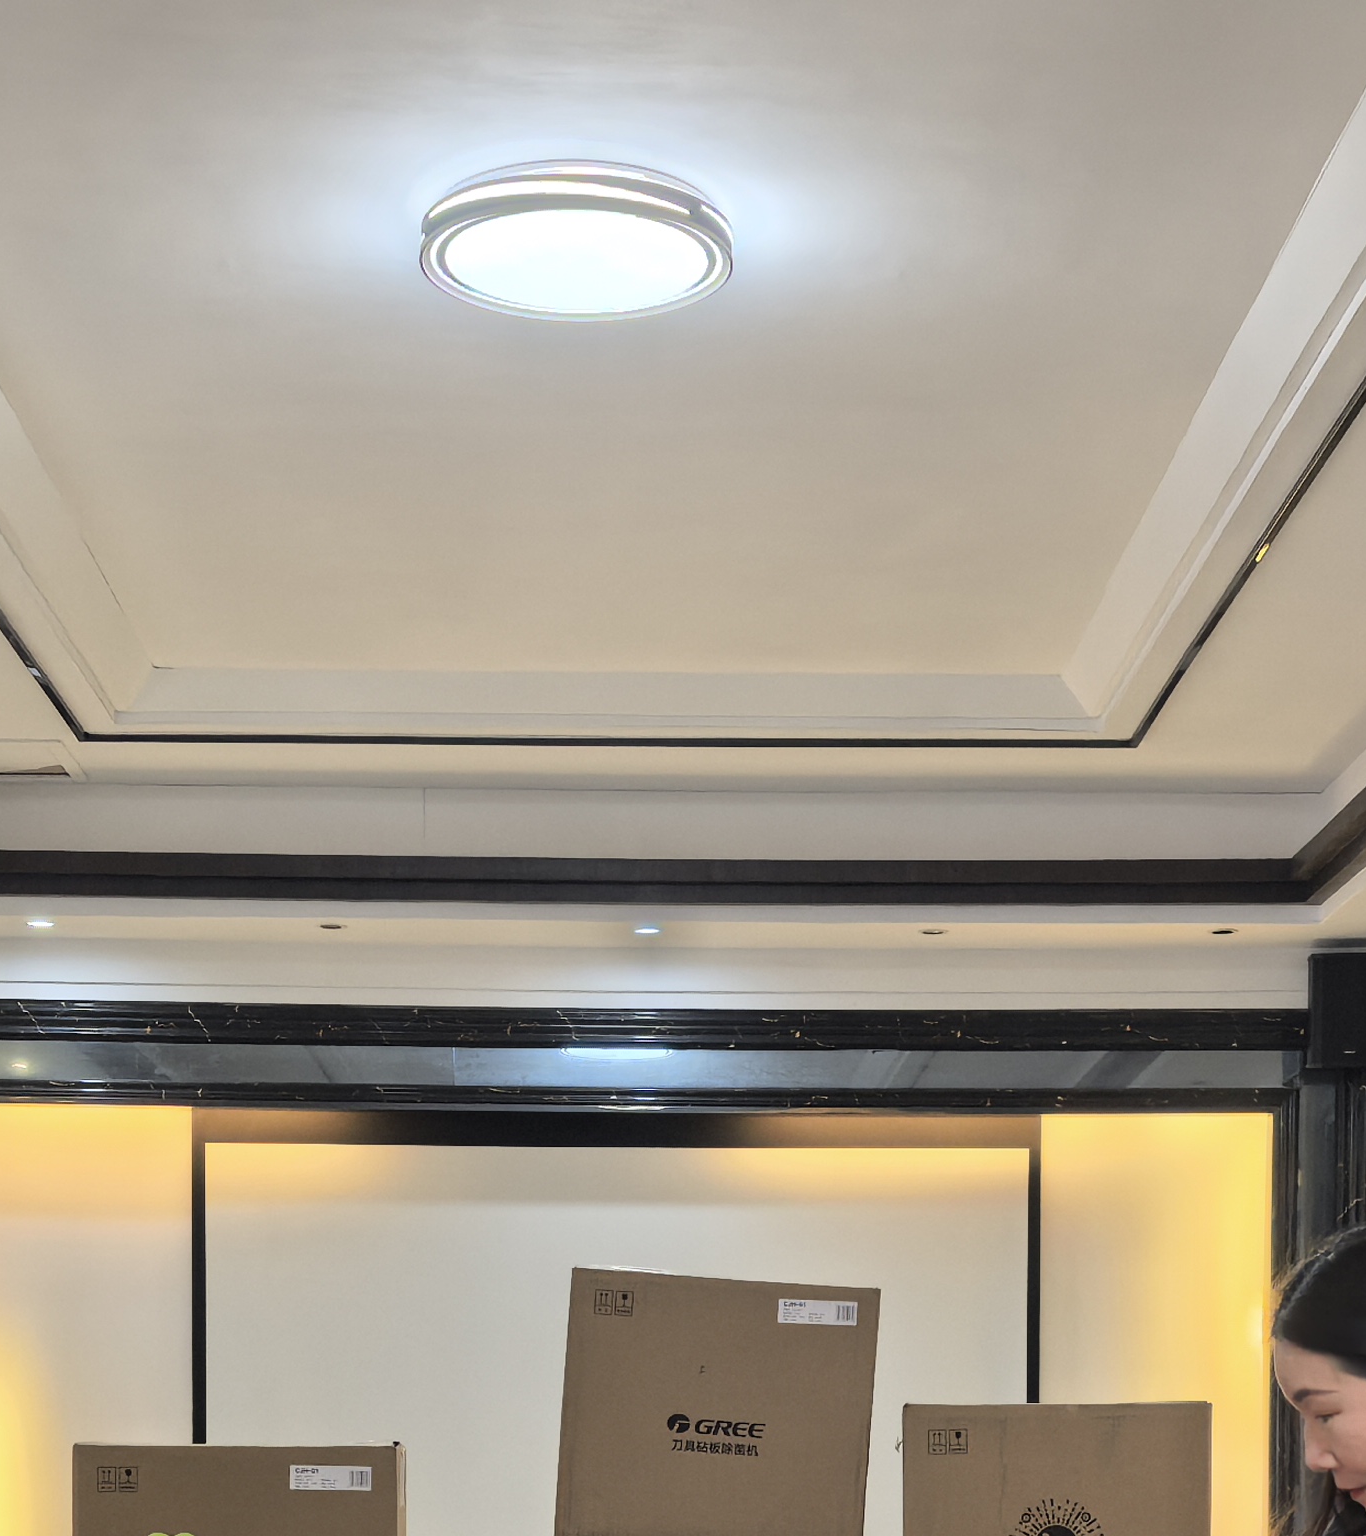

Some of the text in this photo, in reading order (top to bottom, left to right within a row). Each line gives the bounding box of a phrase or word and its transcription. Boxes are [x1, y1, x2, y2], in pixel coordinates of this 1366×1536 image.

[694, 1418, 766, 1440] GREE
[671, 1439, 759, 1458] 刀具砧板除菌机
